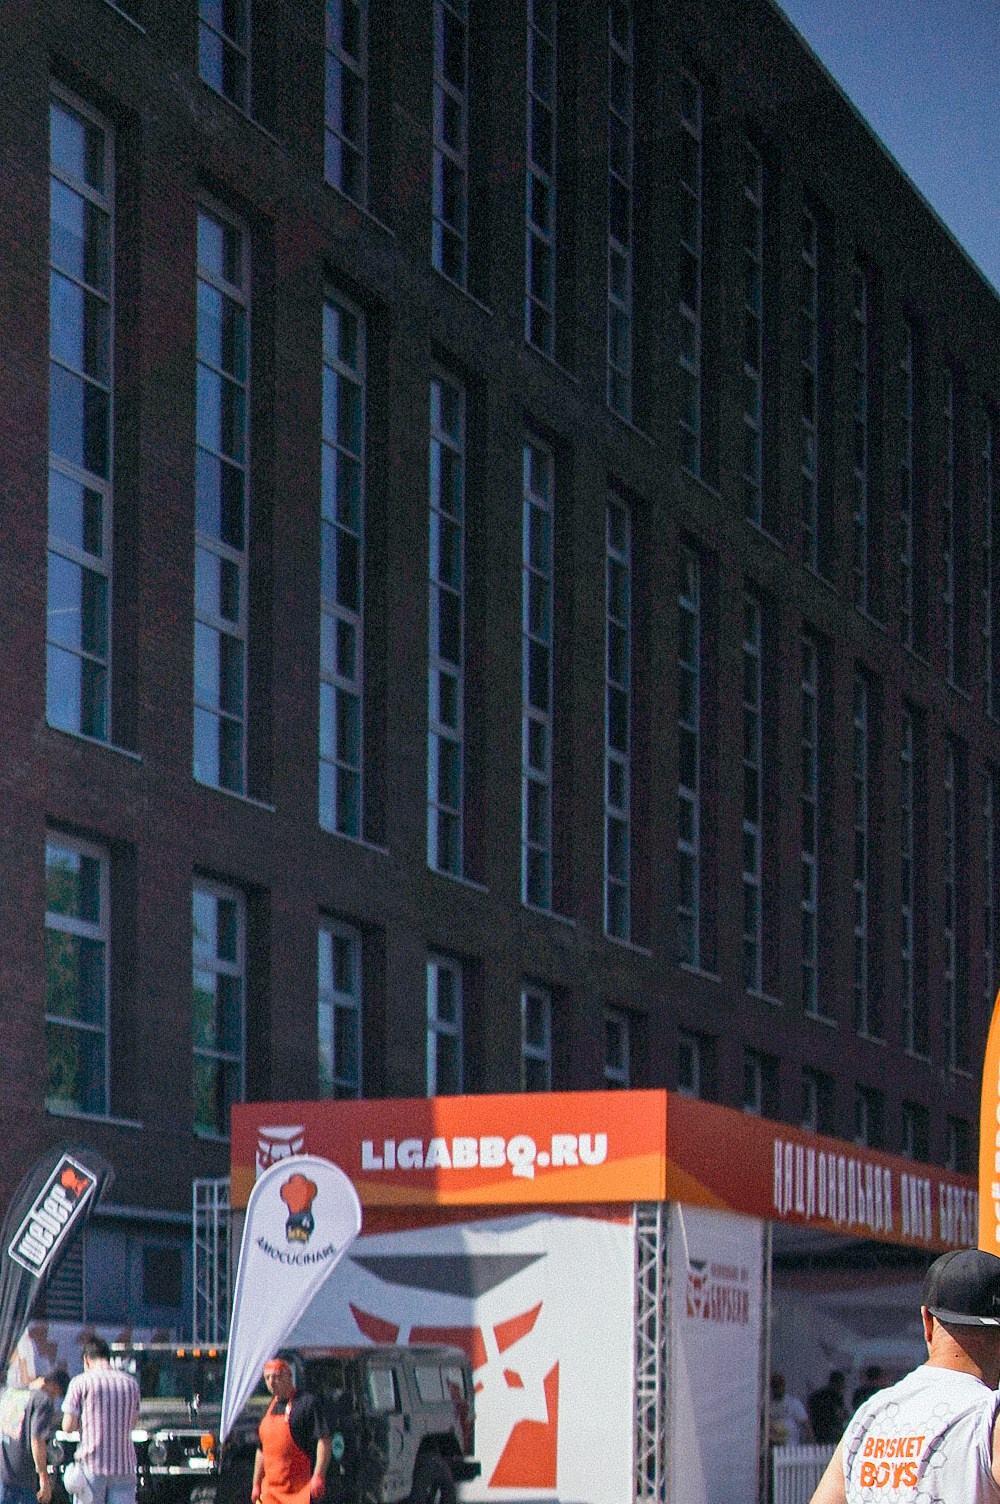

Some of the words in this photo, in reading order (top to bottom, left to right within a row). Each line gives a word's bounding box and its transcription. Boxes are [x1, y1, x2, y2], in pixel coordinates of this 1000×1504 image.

[361, 1133, 608, 1180] LIGABBQ.RU
[18, 1183, 74, 1266] weber
[863, 1436, 926, 1459] BRISKET
[860, 1461, 918, 1489] BOYS
